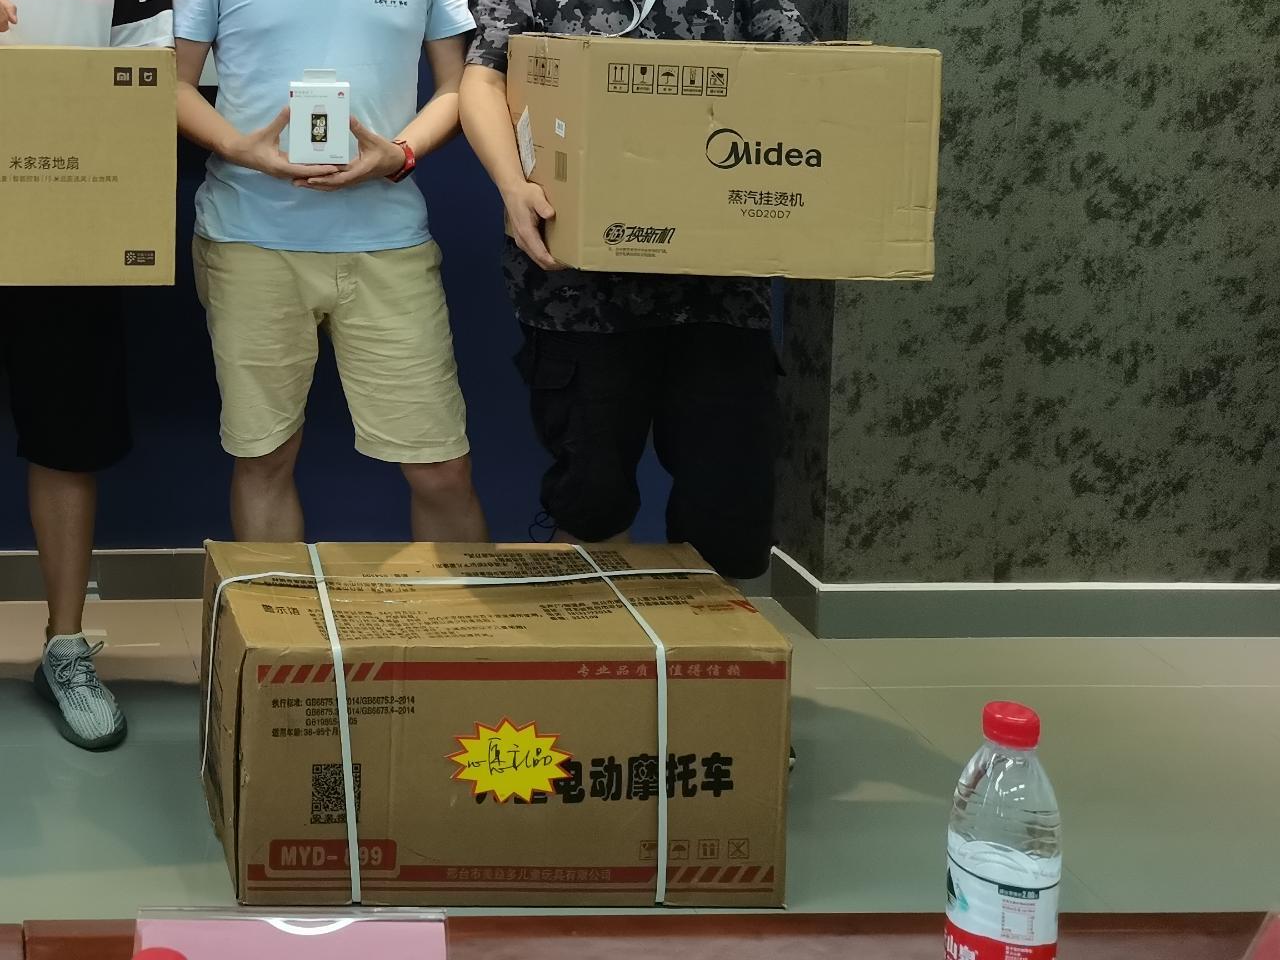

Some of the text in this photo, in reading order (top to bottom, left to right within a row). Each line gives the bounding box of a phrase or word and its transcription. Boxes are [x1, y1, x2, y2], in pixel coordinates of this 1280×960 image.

[706, 128, 822, 170] Midea
[9, 156, 80, 170] 米家落地扇
[728, 189, 805, 207] 蒸汽挂烫机
[740, 208, 792, 220] YGD20D7
[577, 663, 742, 678] 专业品质 值得信赖
[475, 751, 734, 804] 电动摩托车
